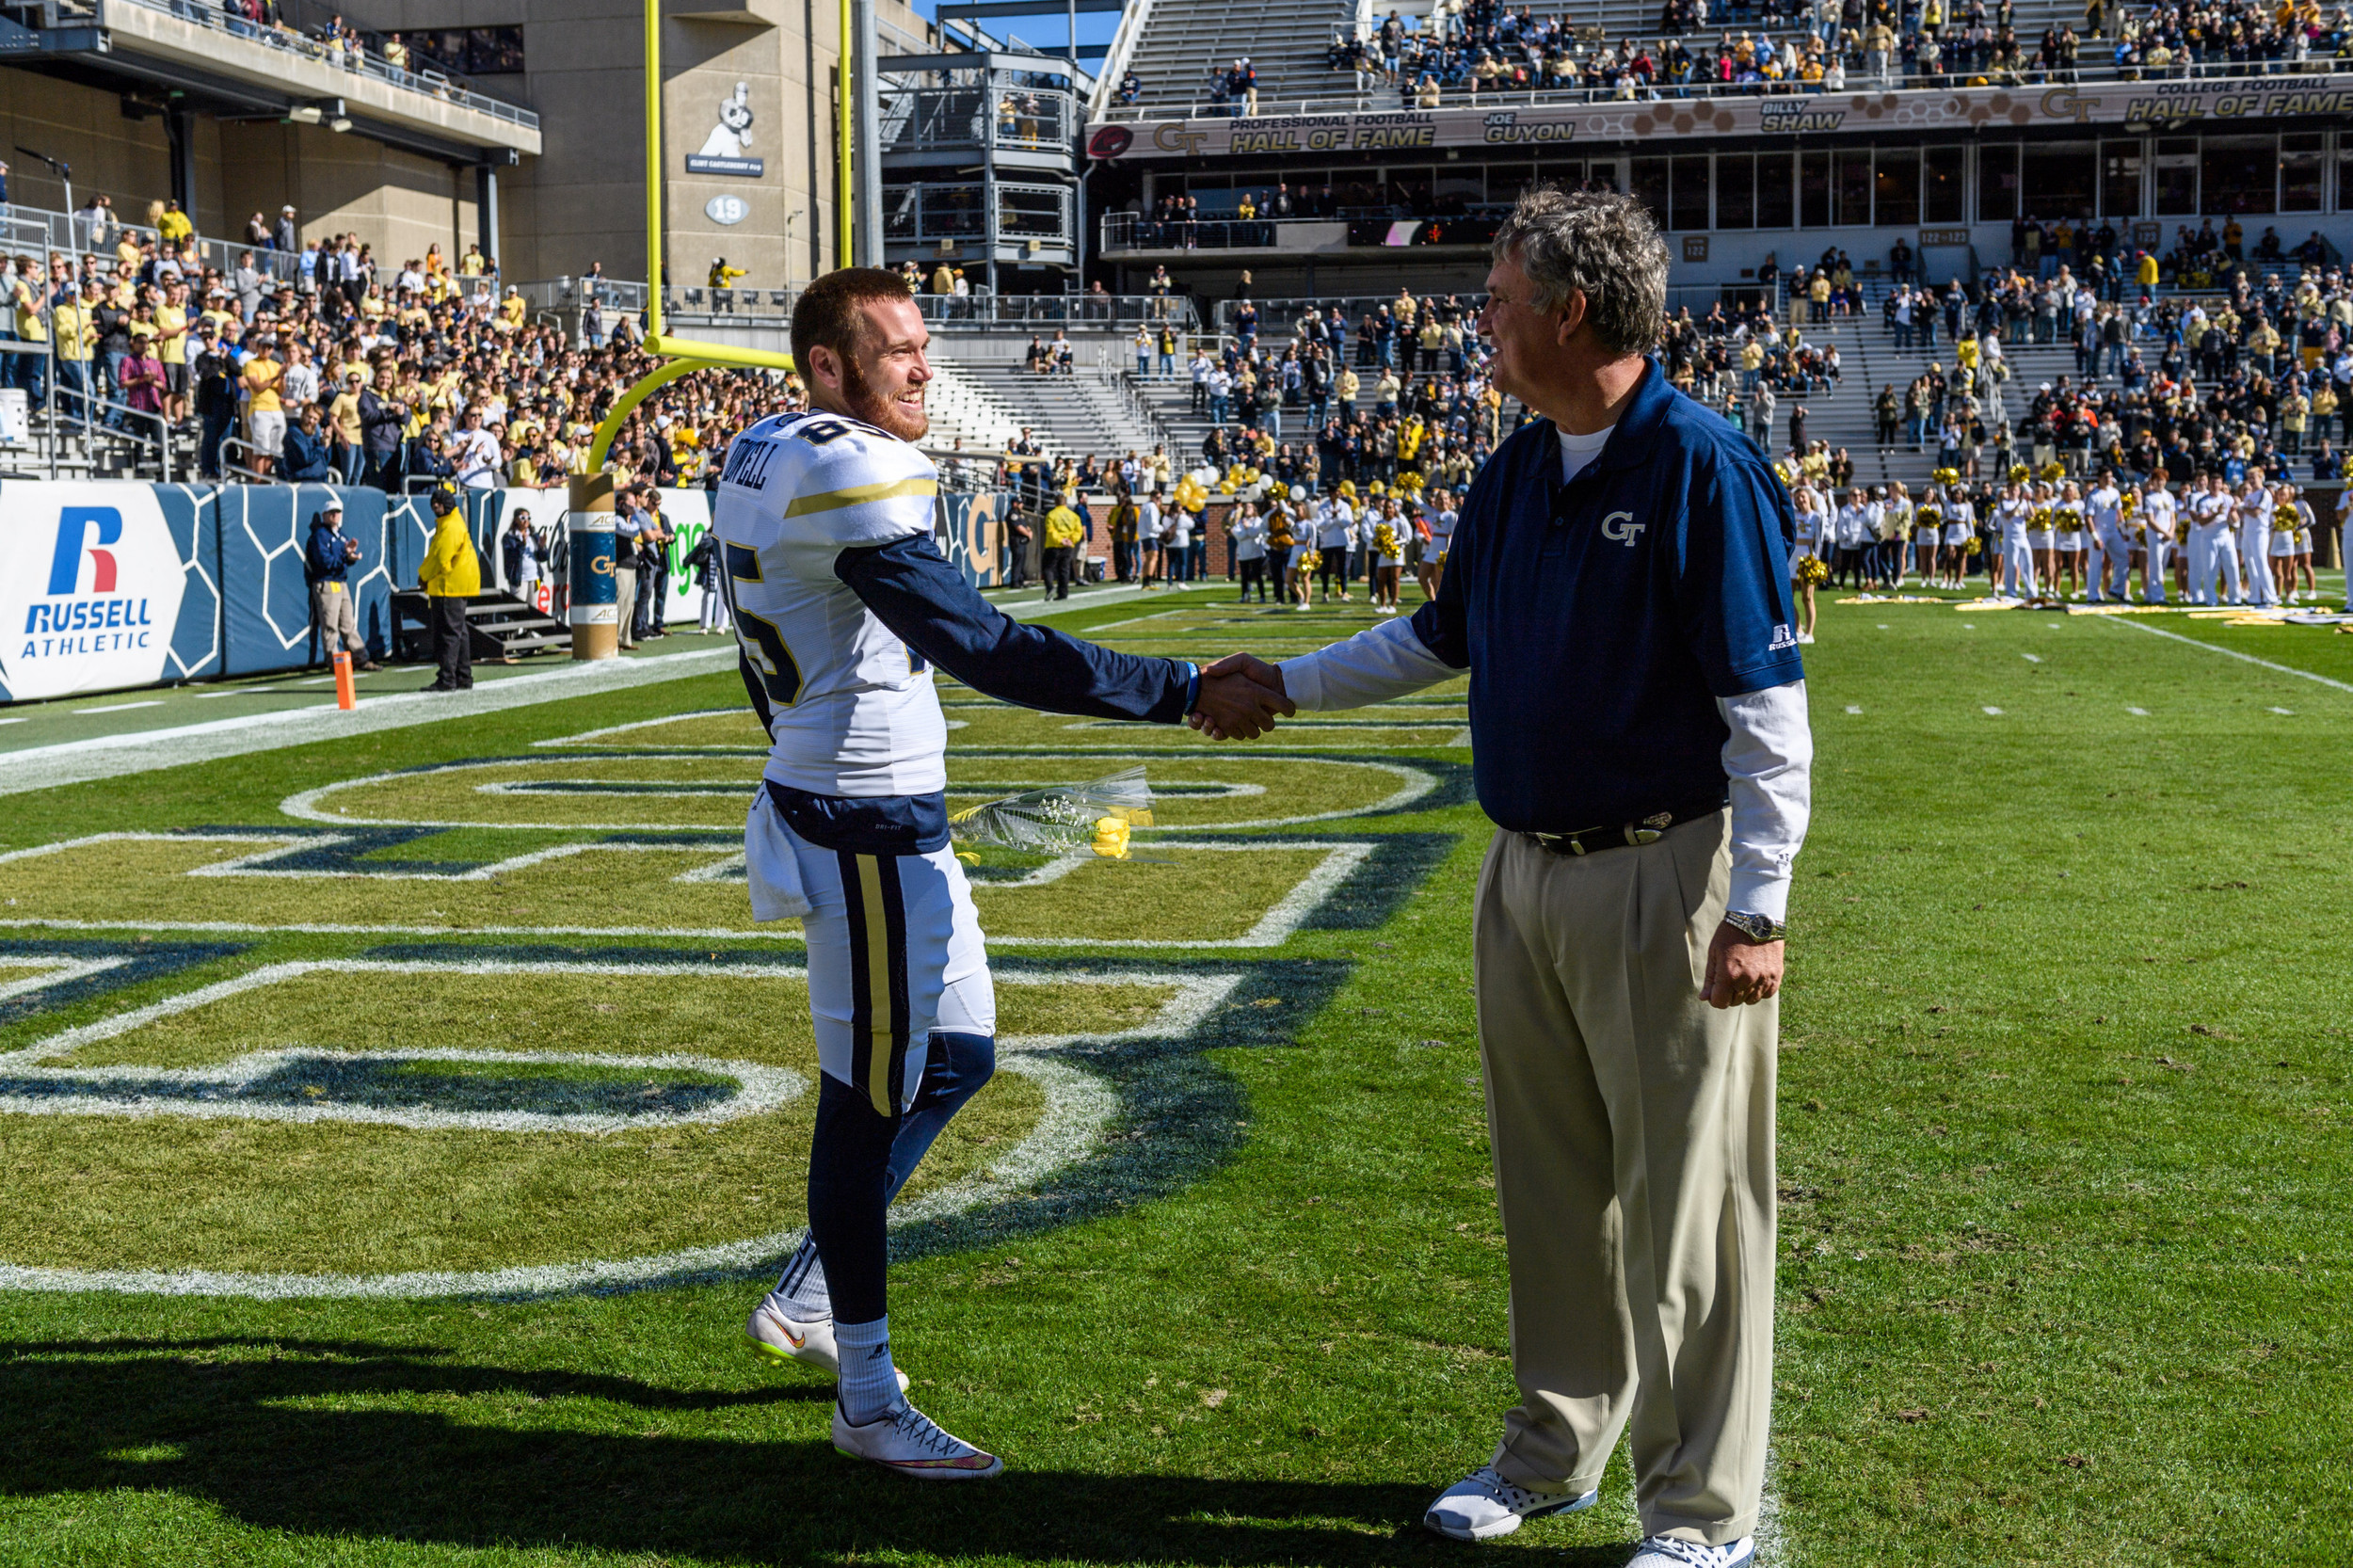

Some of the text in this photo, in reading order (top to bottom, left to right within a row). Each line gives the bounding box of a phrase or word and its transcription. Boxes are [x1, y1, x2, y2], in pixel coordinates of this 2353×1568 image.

[2156, 77, 2329, 94] COLLEGE FOOTBALL
[1760, 100, 1809, 116] BILLY
[2125, 92, 2353, 120] HALL OF FAME
[1229, 112, 1433, 131] PROFESSIONAL FOOTBALL
[1483, 111, 1516, 126] JOE
[1761, 111, 1847, 132] SHAW
[1230, 126, 1436, 153] HALL OF FAME
[1484, 122, 1575, 142] GUYON
[714, 198, 742, 219] 19
[1602, 511, 1645, 547] GT
[24, 599, 152, 634] RUSSELL
[21, 632, 151, 659] ATHLETIC
[875, 823, 903, 831] DRI-FIT
